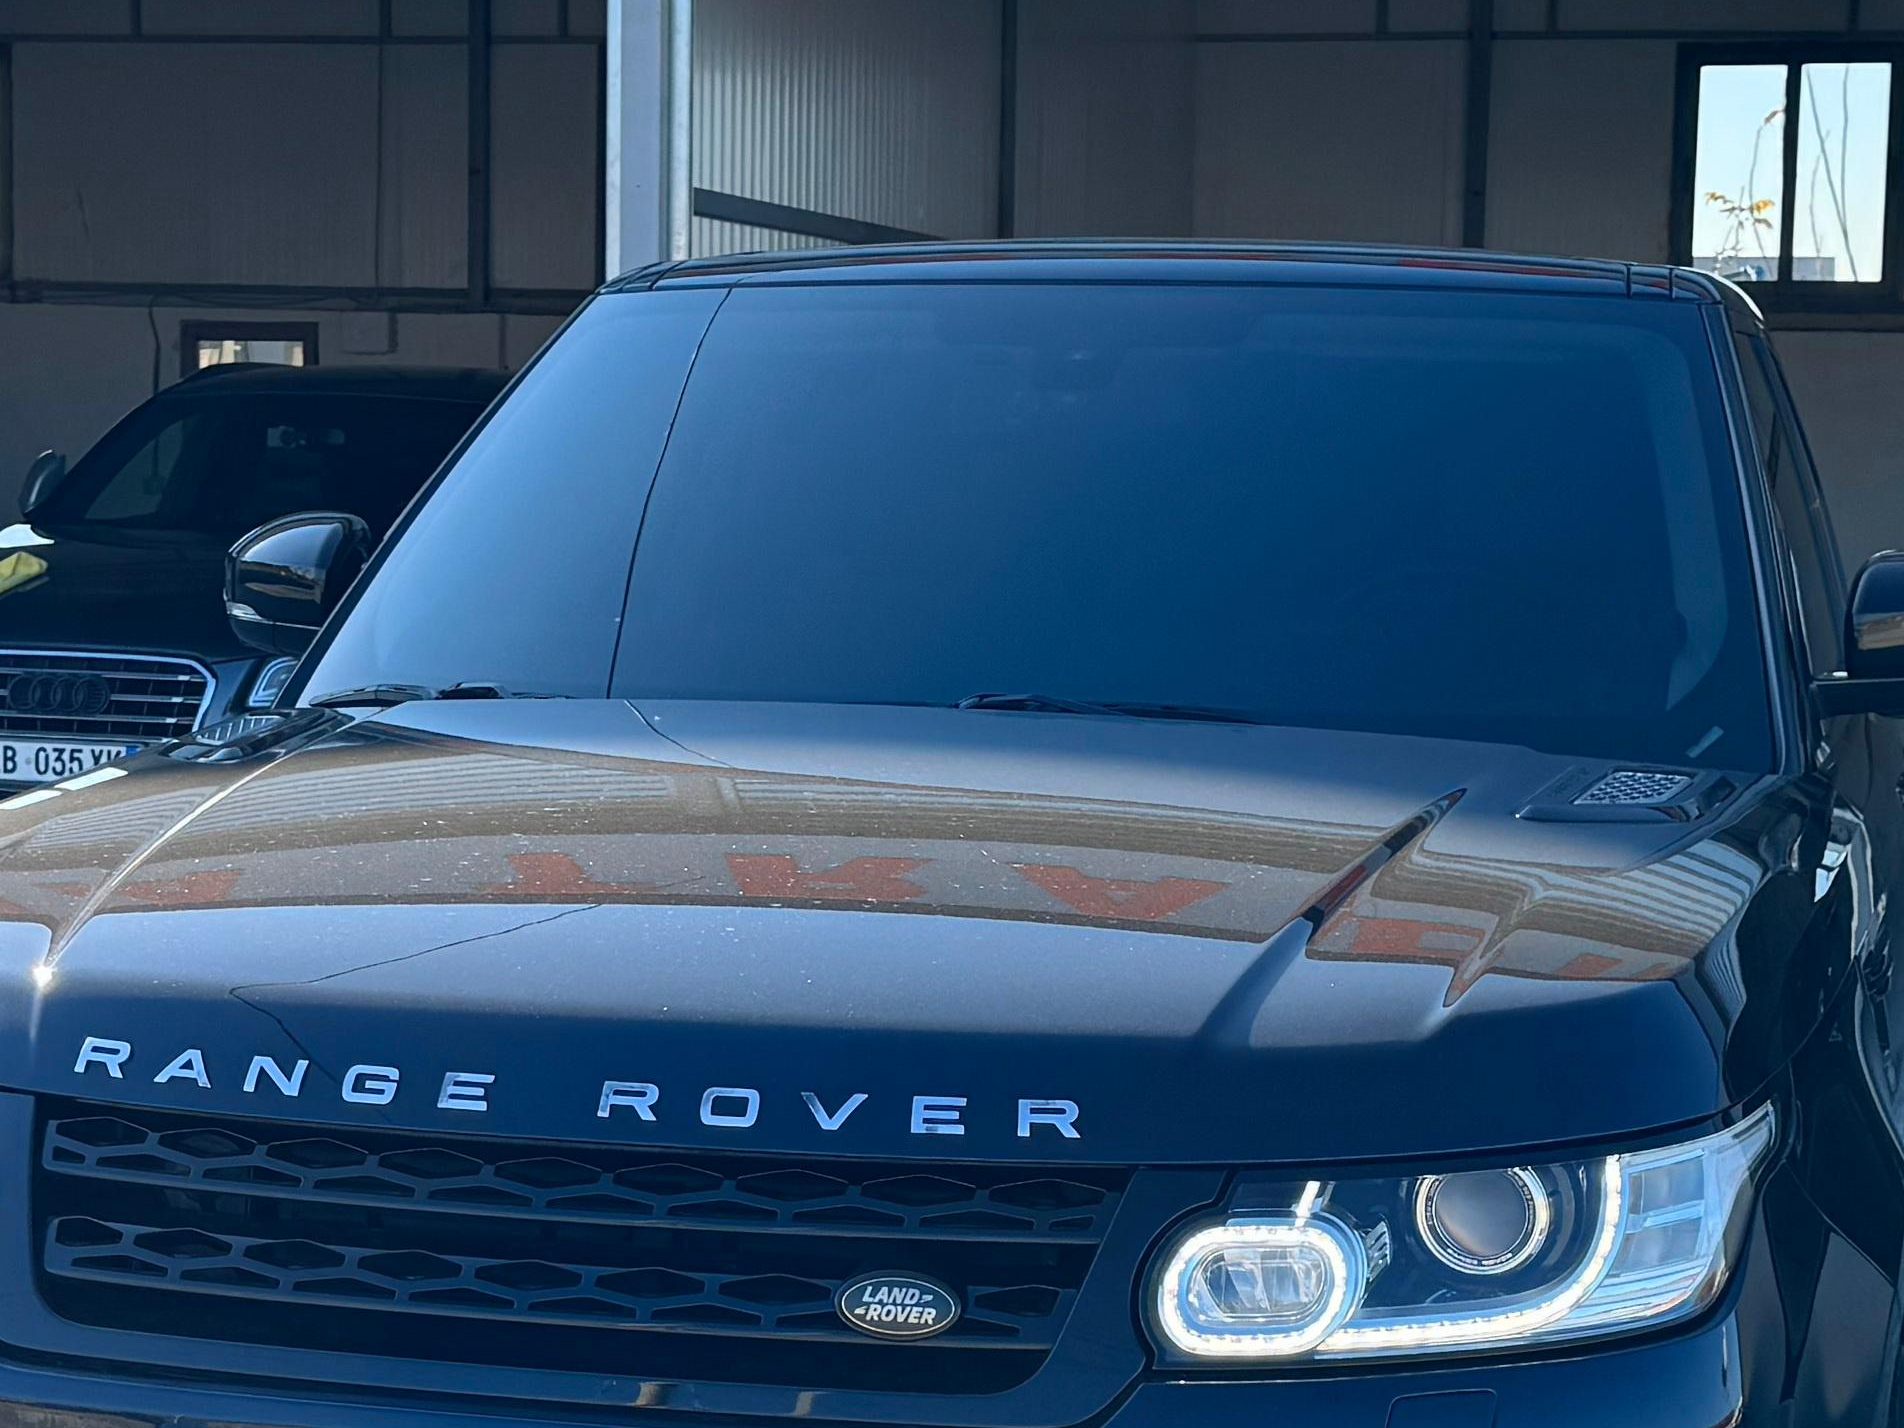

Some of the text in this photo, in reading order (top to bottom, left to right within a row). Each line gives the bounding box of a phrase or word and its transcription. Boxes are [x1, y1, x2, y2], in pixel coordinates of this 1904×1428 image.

[35, 746, 83, 776] 035
[73, 1036, 1081, 1139] RANGE ROVER
[862, 1285, 920, 1305] LAND
[865, 1303, 937, 1325] ROVER
